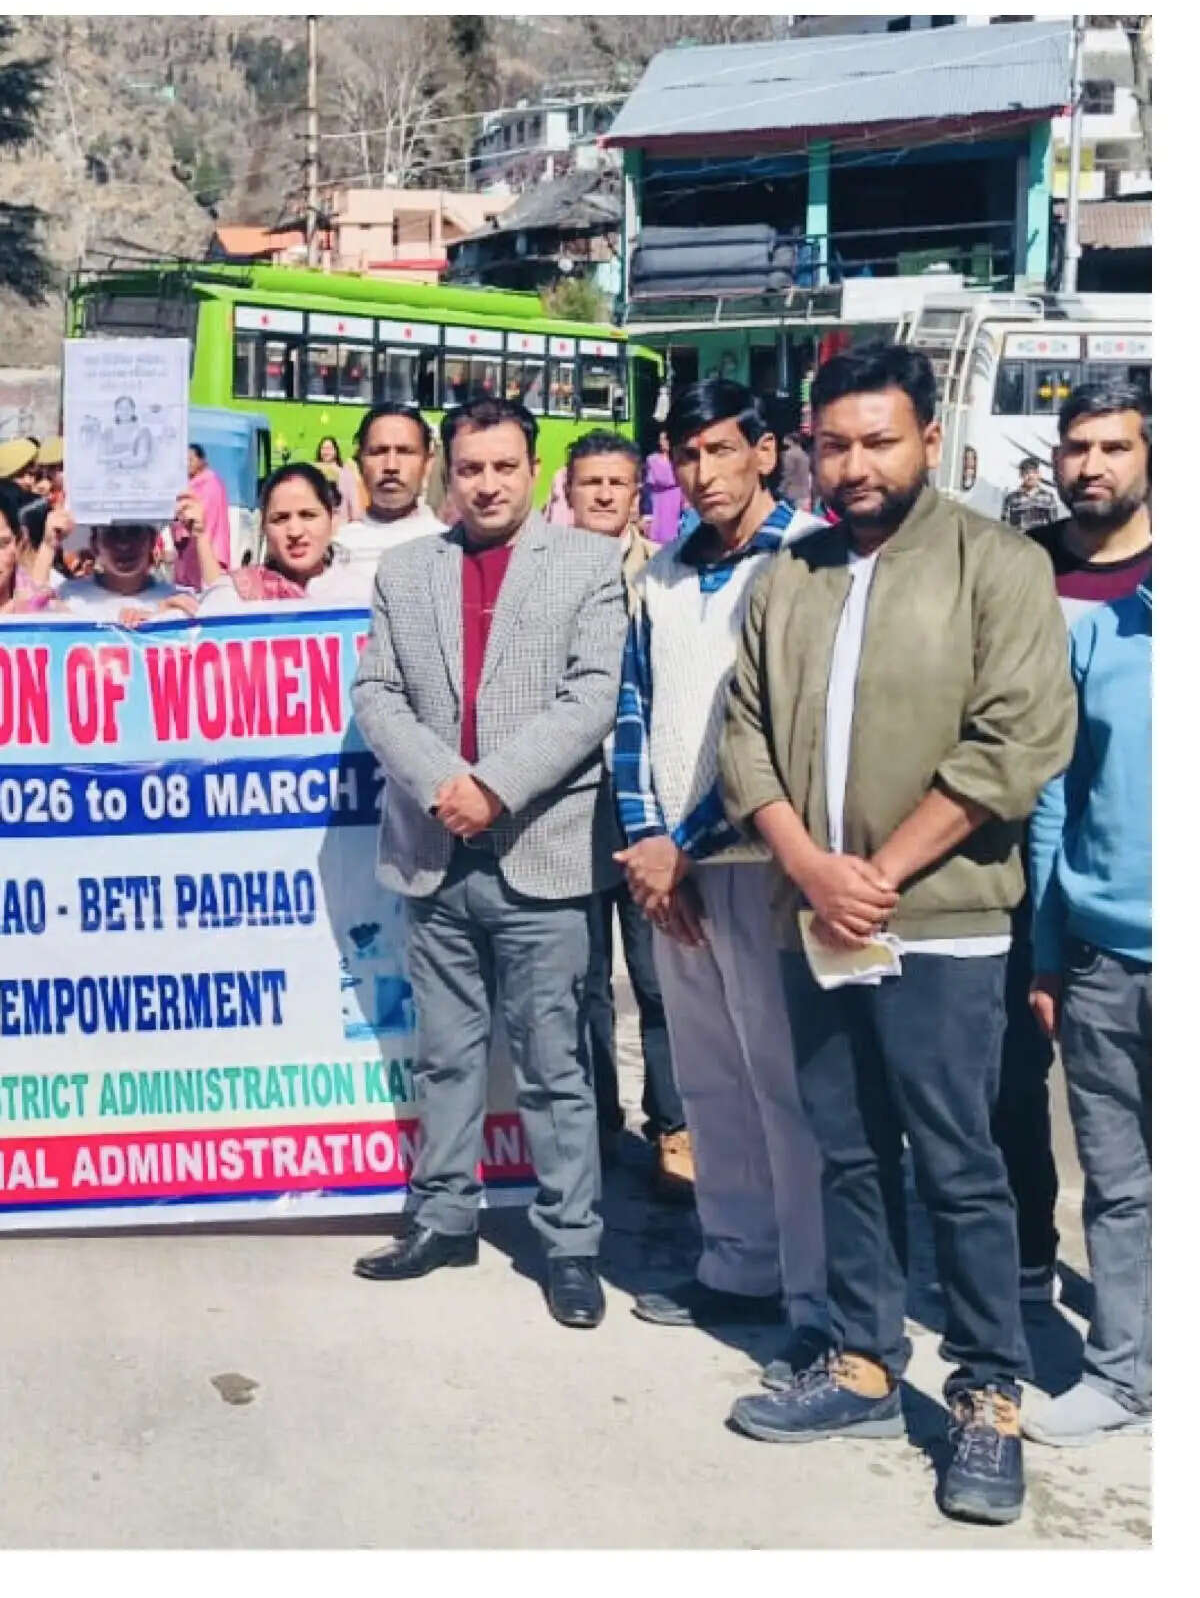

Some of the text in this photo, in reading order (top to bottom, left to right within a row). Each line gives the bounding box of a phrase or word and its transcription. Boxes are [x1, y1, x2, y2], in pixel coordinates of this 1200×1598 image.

[66, 645, 131, 745] OF
[146, 633, 343, 741] WOMEN
[85, 778, 128, 823] to
[141, 772, 191, 820] 08
[204, 766, 359, 819] MARCH
[78, 874, 164, 933] BETI
[173, 868, 316, 930] PADHAO
[99, 1062, 355, 1118] ADMINISTRATION
[71, 1129, 425, 1188] ADMINISTRATION
